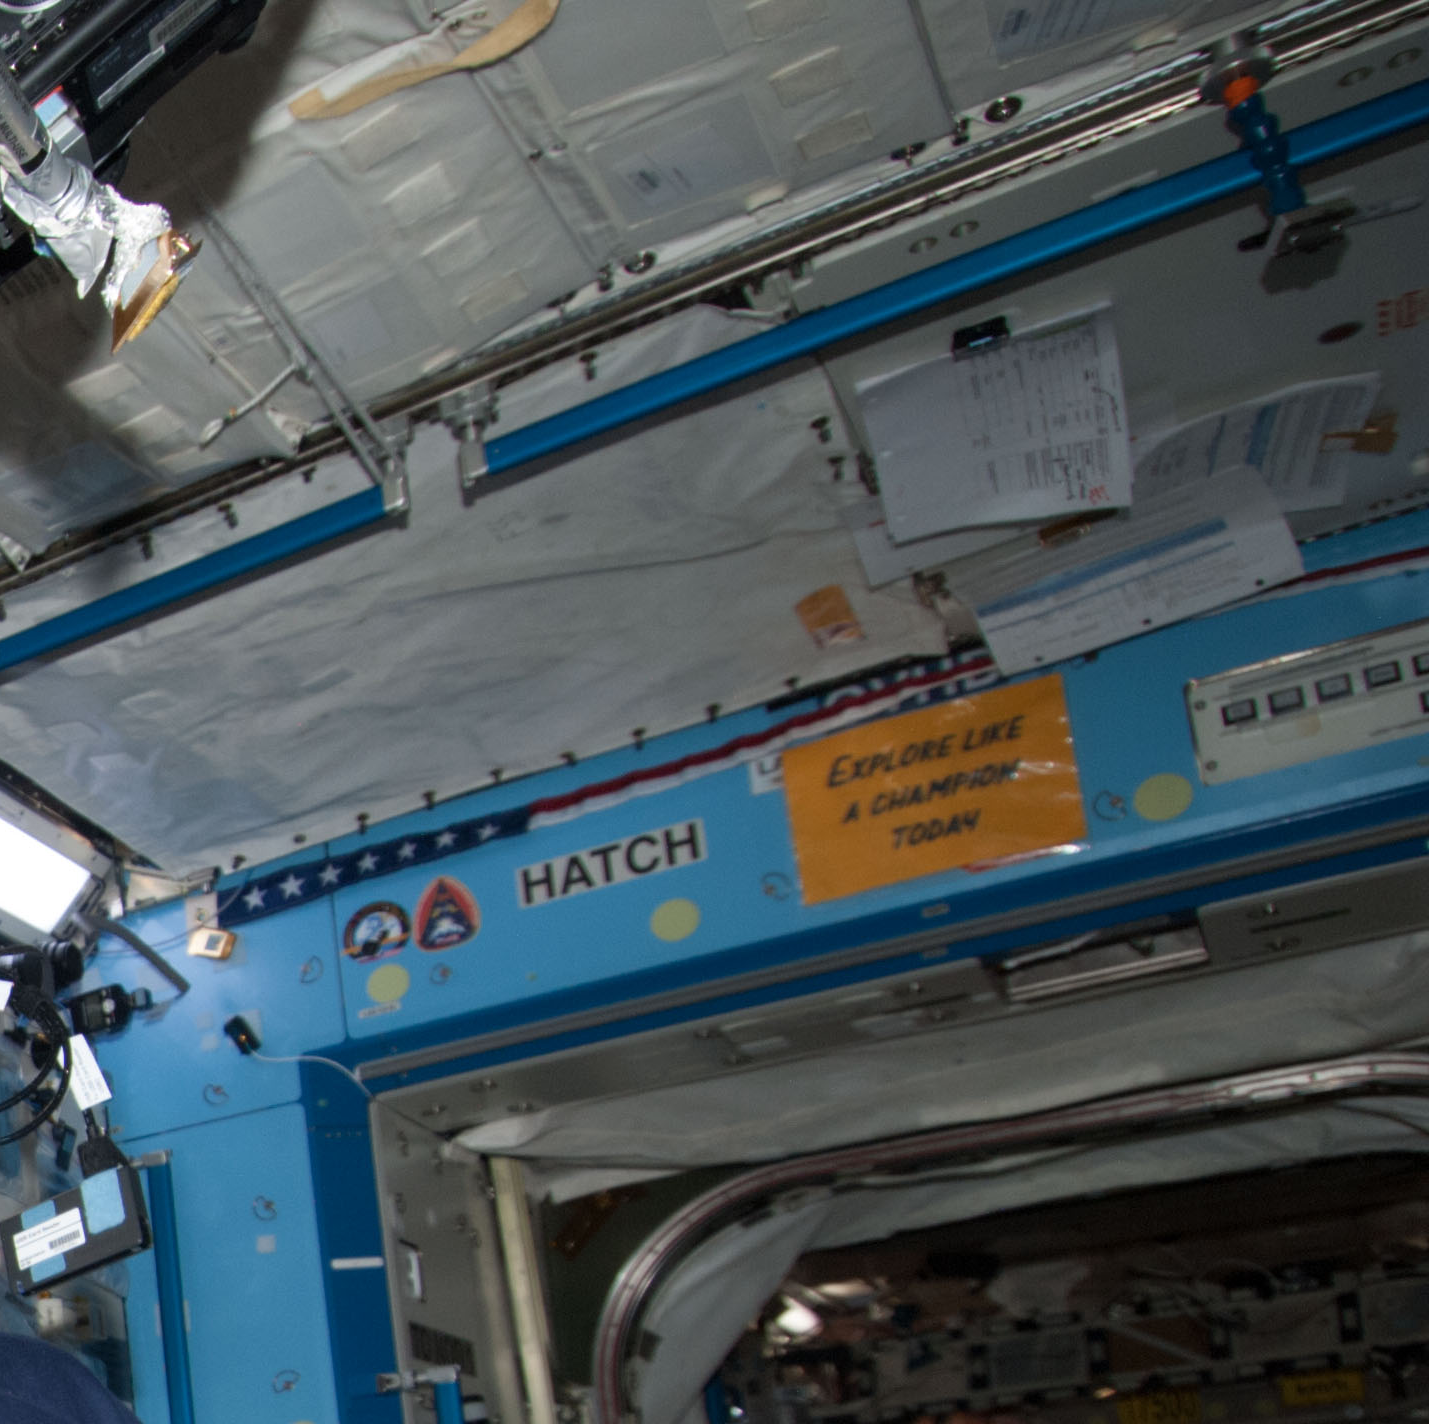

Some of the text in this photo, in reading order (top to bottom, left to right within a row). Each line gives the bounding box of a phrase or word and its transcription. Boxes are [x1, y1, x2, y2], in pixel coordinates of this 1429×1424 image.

[826, 734, 955, 789] EXPLORE
[964, 715, 1025, 755] LIKE
[843, 758, 1022, 824] A CHAMPION
[522, 822, 702, 904] HATCH
[891, 809, 982, 850] TODAY
